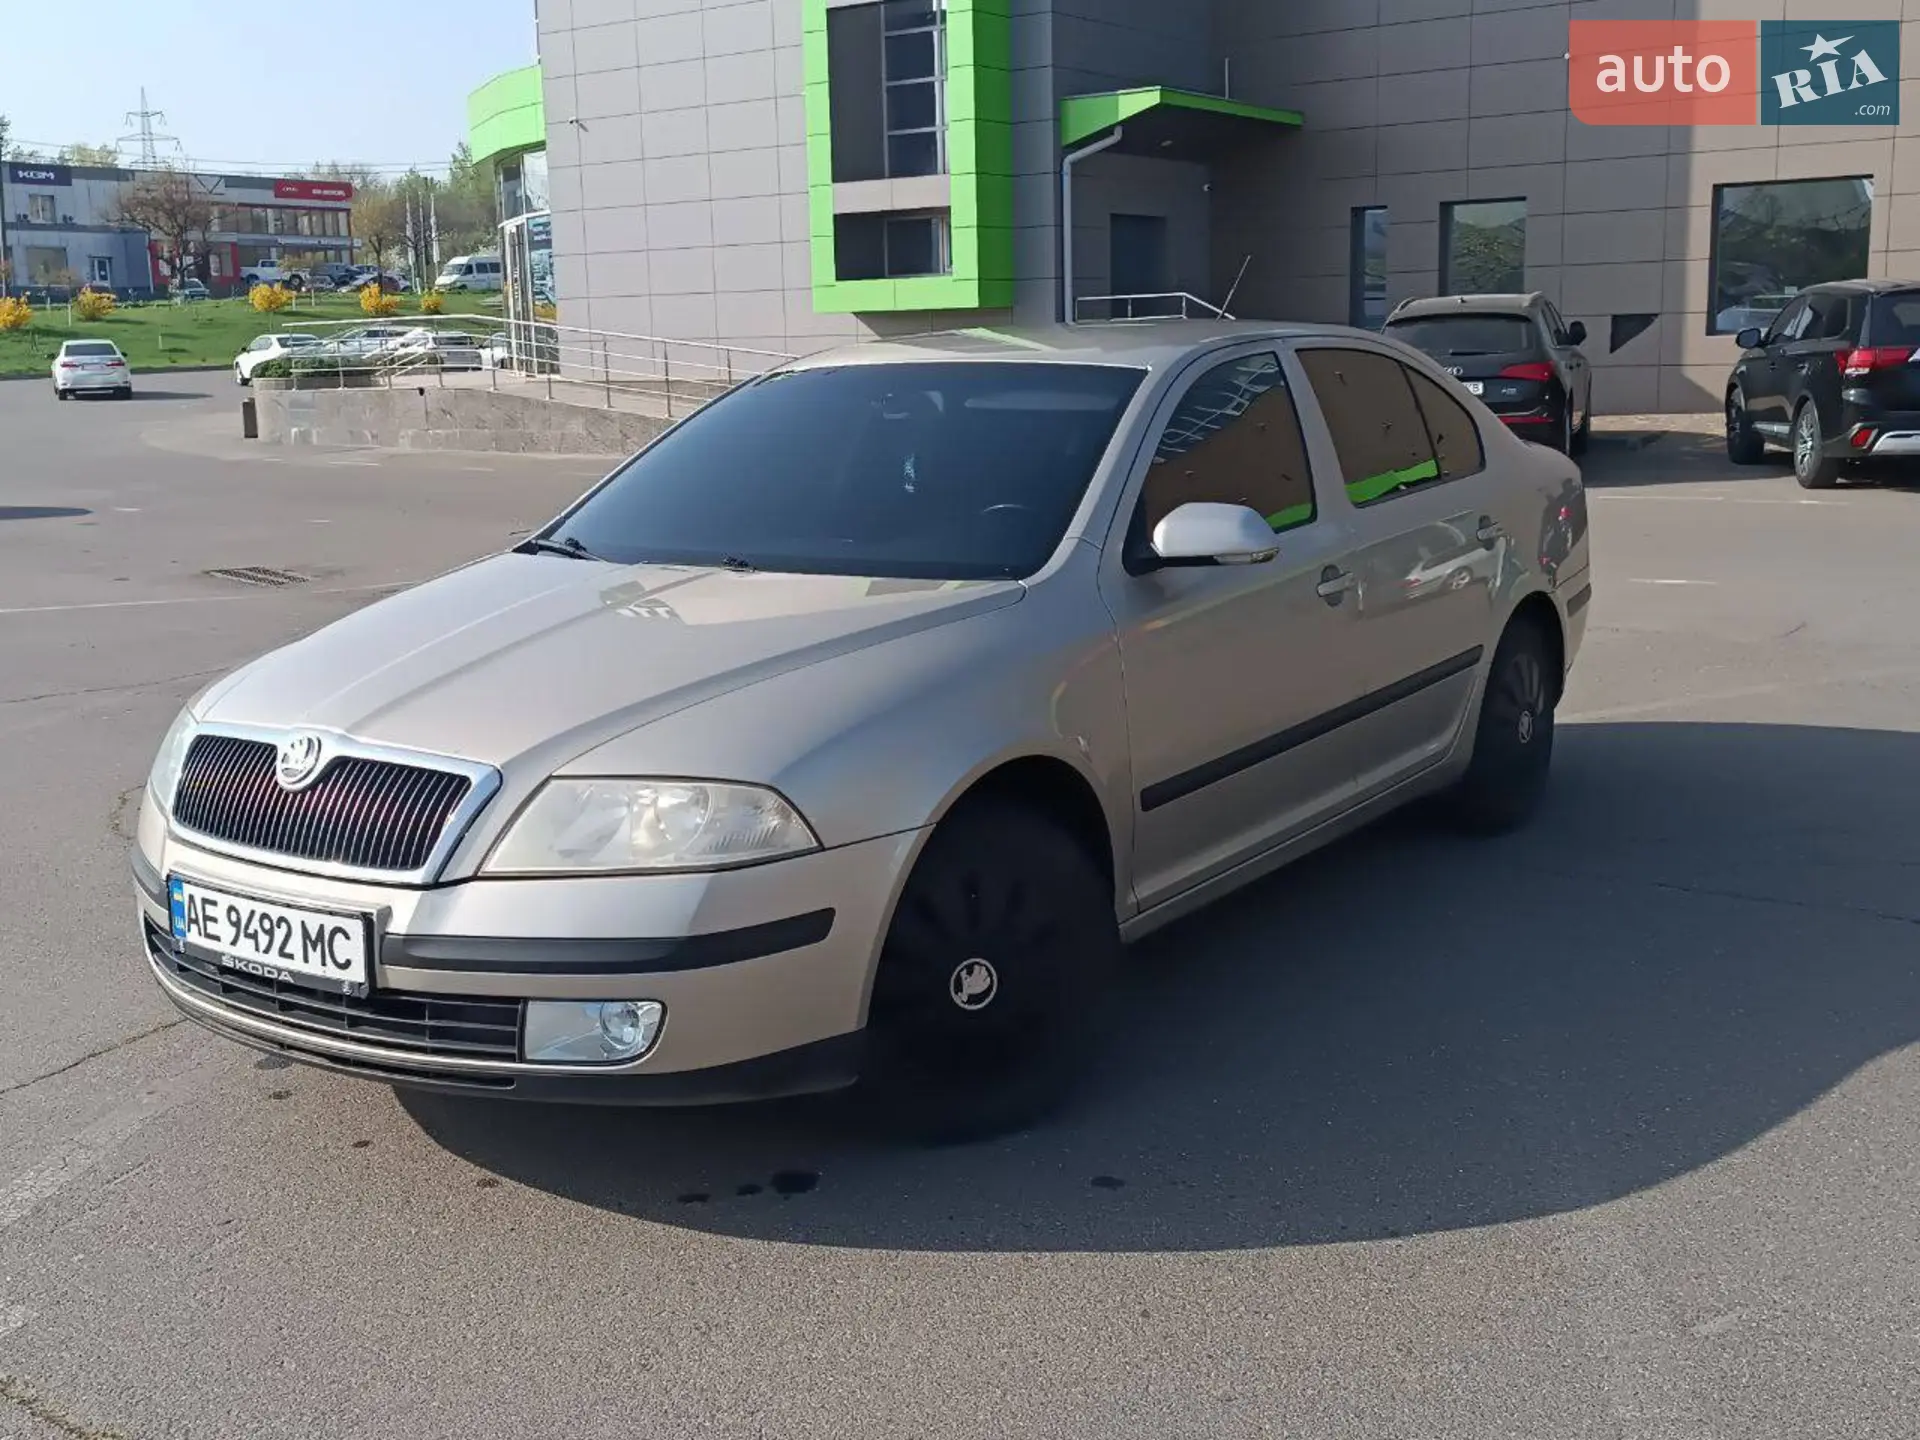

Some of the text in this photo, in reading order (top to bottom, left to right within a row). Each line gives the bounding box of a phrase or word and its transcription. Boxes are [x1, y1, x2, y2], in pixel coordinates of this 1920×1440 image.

[187, 893, 352, 971] AE 9492 MC
